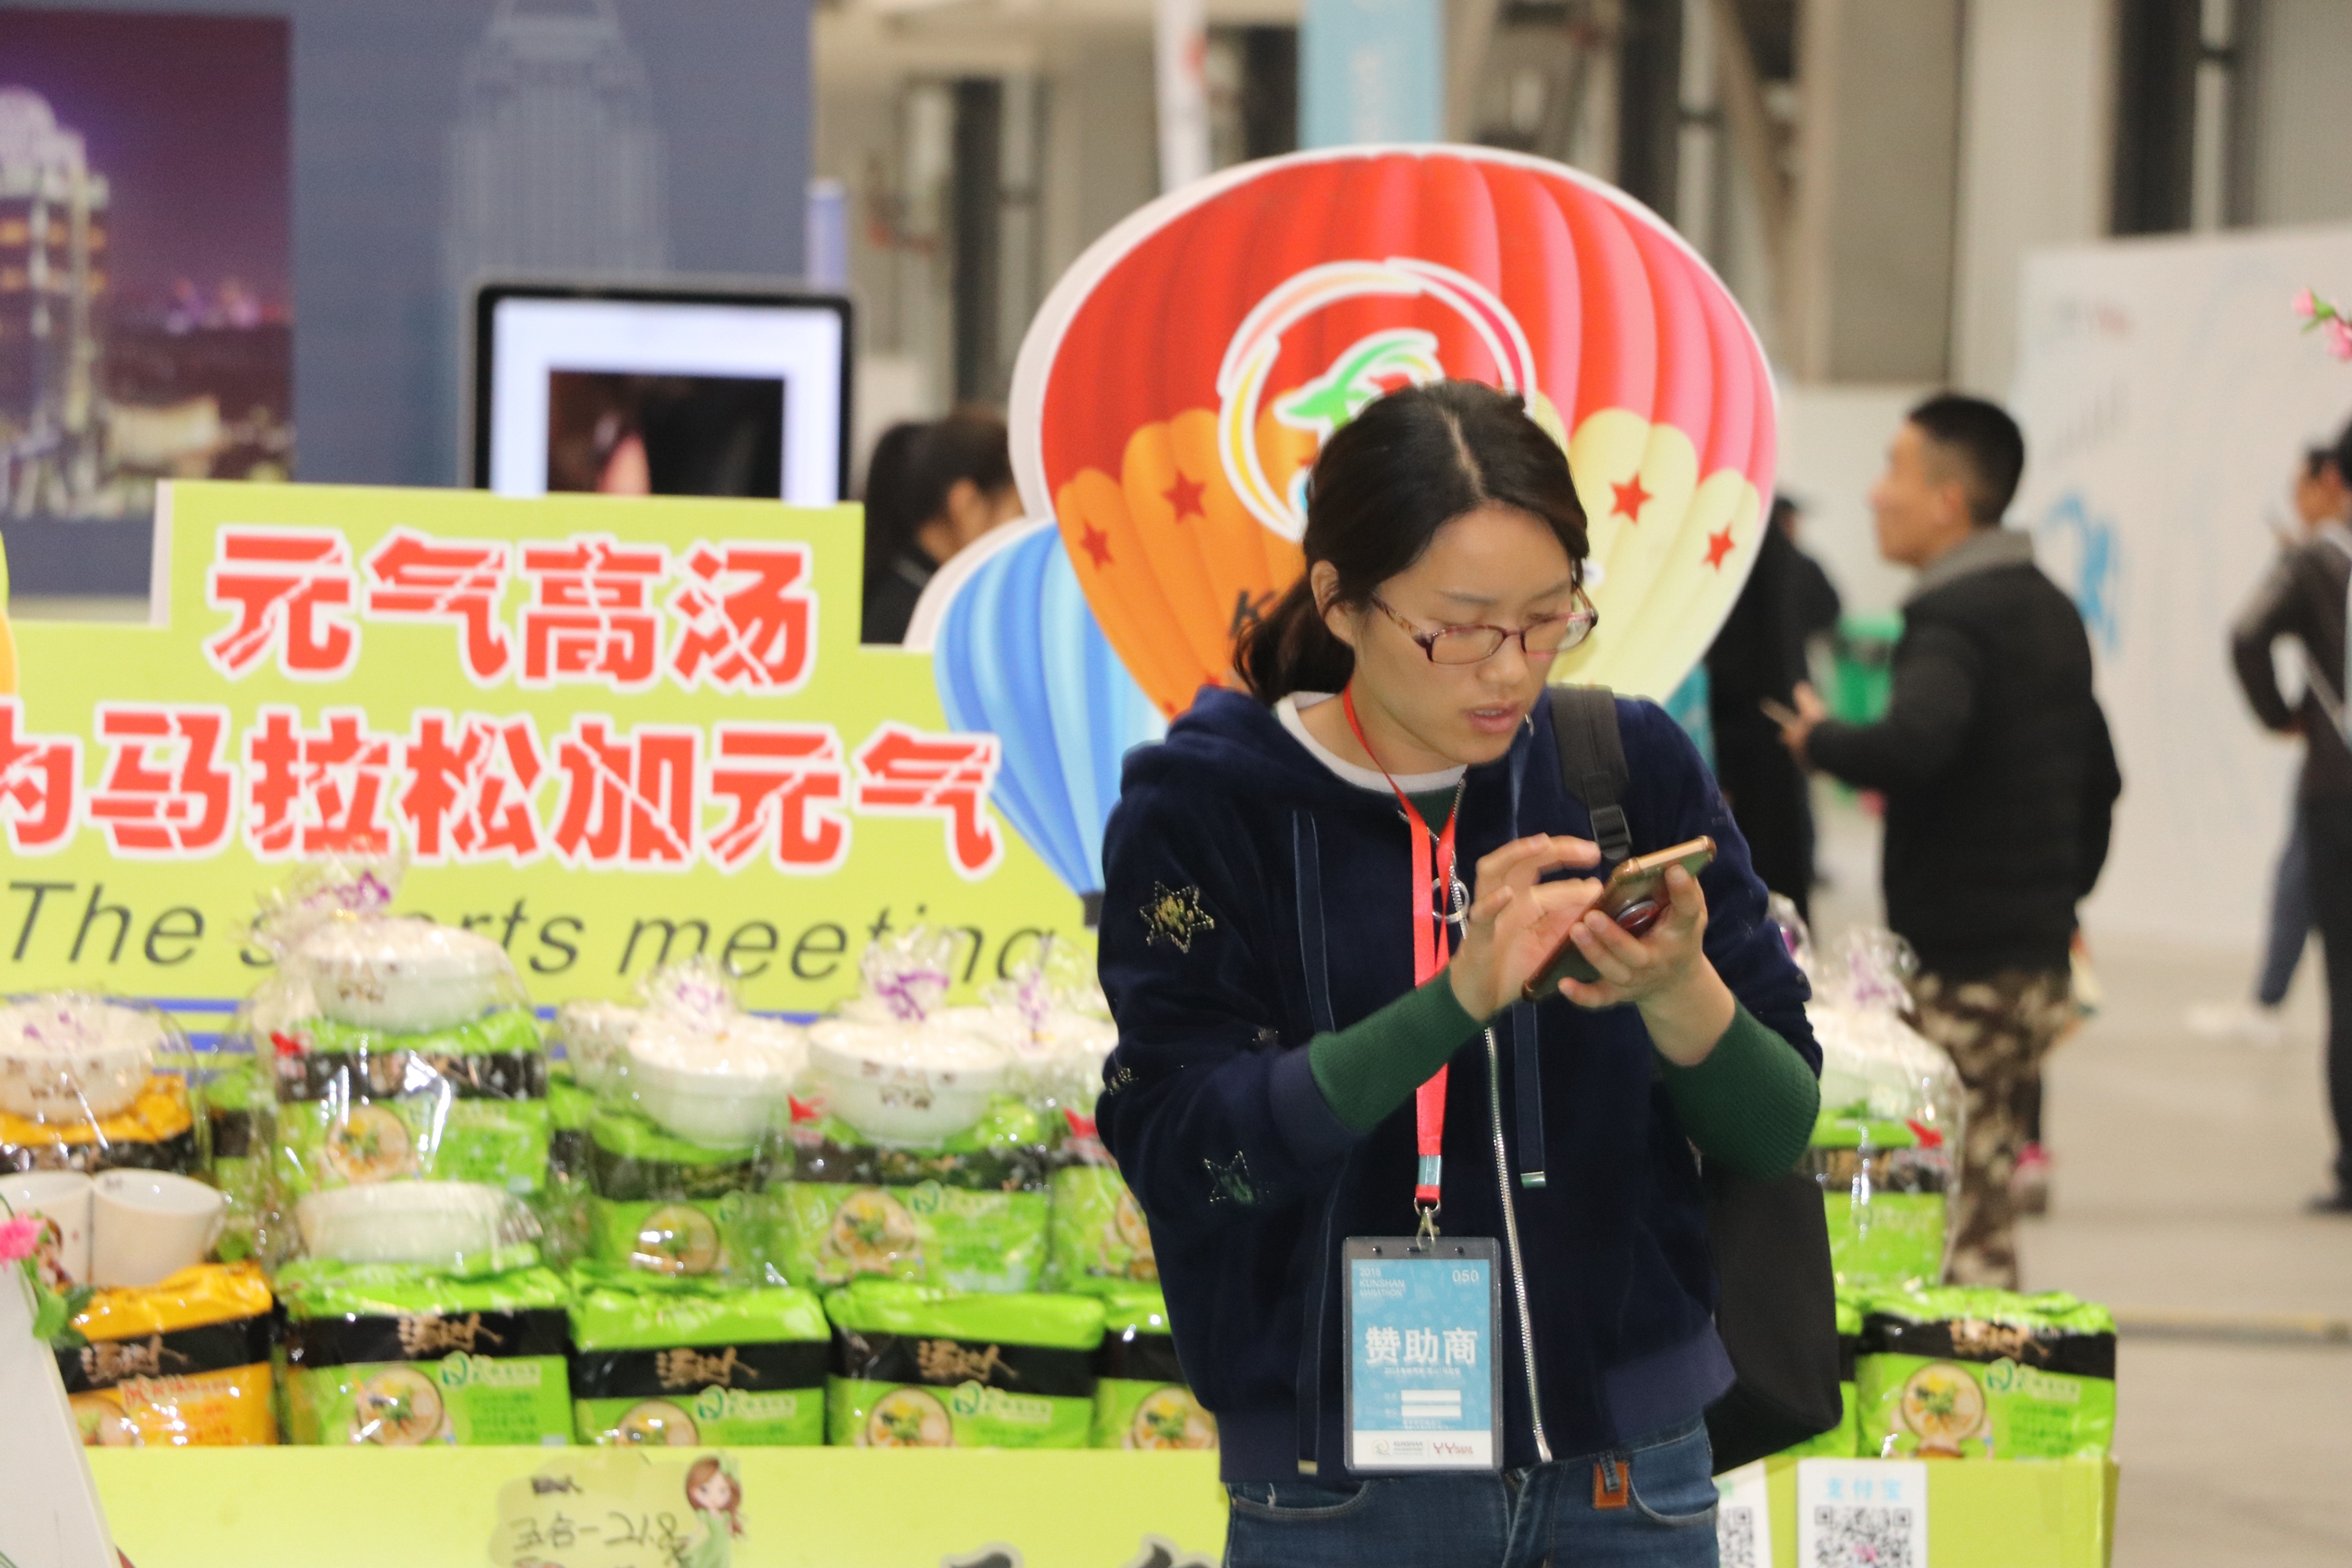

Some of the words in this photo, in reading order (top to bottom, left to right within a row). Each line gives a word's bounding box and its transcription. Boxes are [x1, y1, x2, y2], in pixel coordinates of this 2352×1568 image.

[207, 532, 814, 690] 元气高汤
[9, 882, 205, 965] The
[1359, 1267, 1381, 1277] 2018
[1359, 1279, 1405, 1288] KUNSHAN
[1451, 1269, 1479, 1283] 050
[1364, 1326, 1479, 1365] 赞助商
